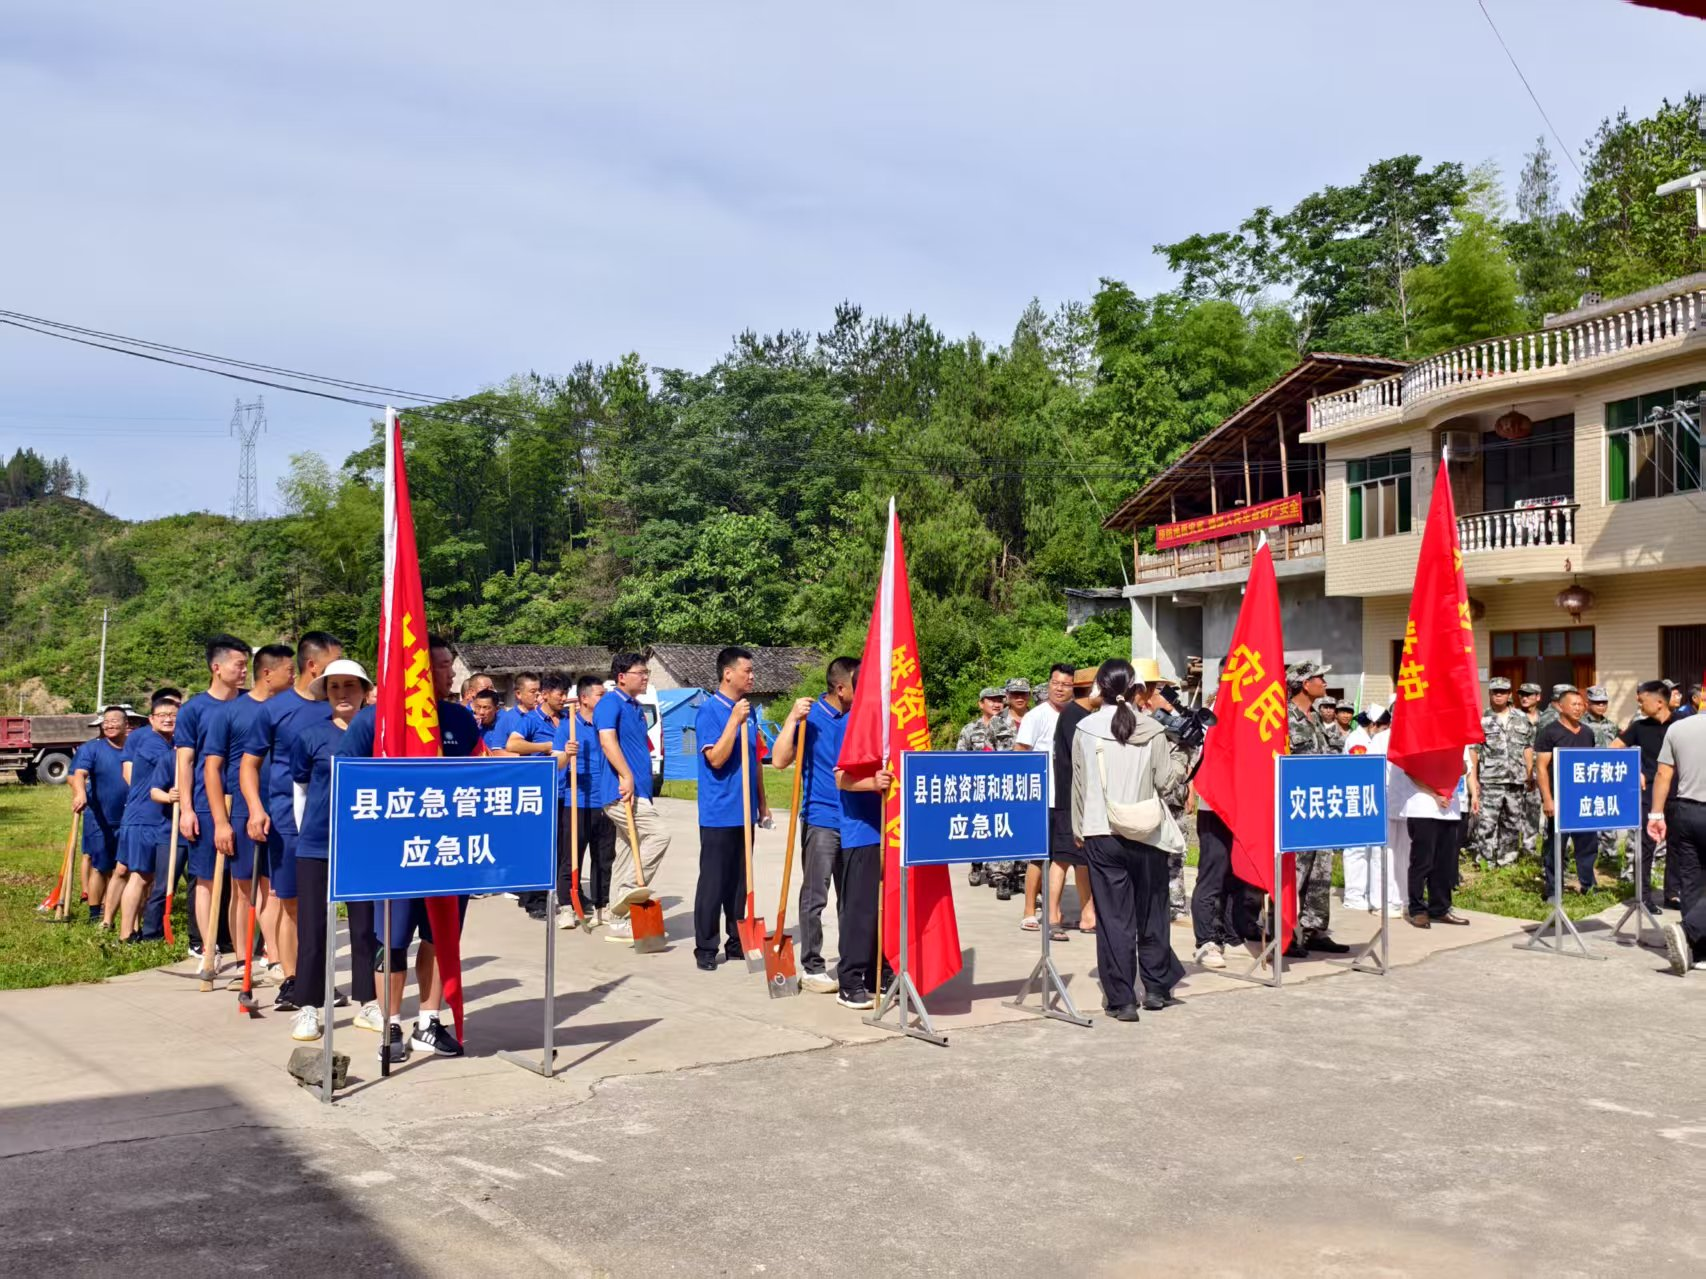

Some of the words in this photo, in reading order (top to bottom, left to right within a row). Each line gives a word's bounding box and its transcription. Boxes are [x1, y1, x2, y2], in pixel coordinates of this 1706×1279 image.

[1221, 644, 1291, 760] 灾民
[1573, 761, 1628, 783] 医疗救护
[350, 786, 543, 820] 县应急管理局
[914, 773, 1042, 804] 县自然资源和规划局
[1290, 784, 1379, 820] 灾民安置队
[1579, 795, 1620, 817] 应急队
[948, 813, 1014, 840] 应急队
[400, 834, 496, 868] 应急队
